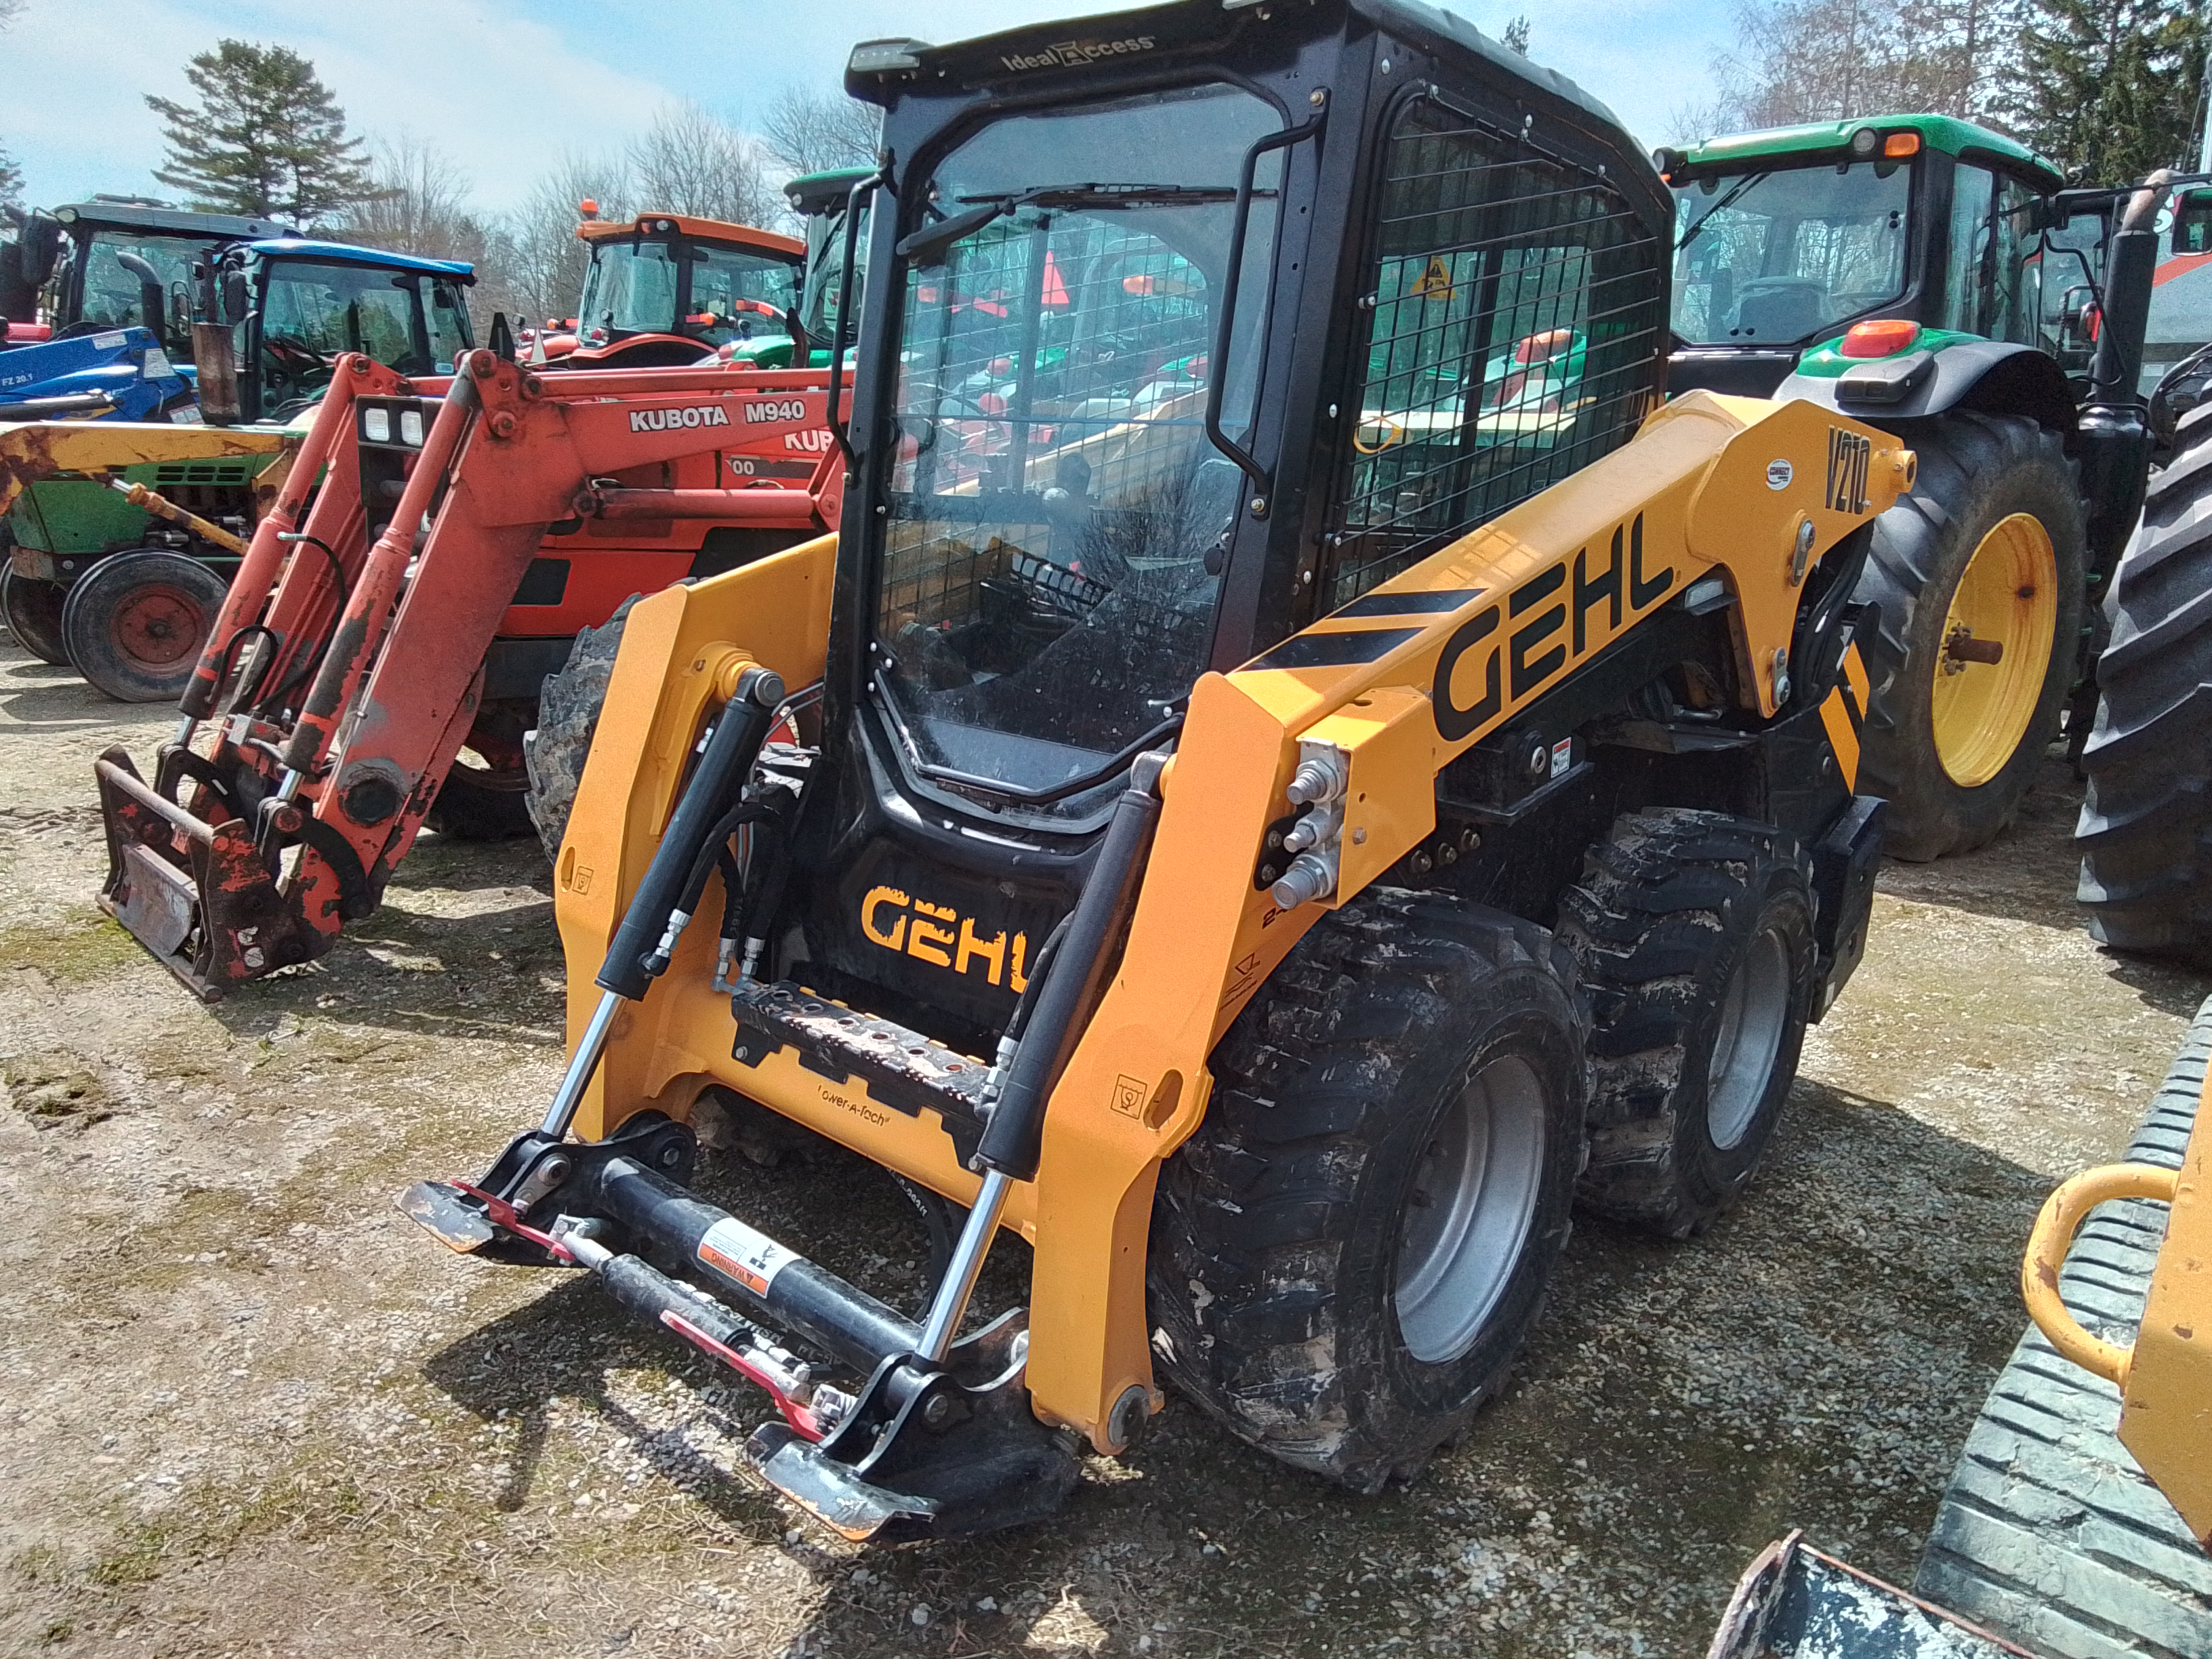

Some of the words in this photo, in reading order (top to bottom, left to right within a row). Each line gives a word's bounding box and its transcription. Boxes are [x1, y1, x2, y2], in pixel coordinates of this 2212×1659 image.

[1, 377, 15, 386] FZ
[16, 373, 33, 385] 20.1
[629, 406, 729, 432] KUBOTA
[745, 401, 805, 423] M940
[1824, 424, 1871, 516] V210
[1432, 510, 1674, 742] GEHL
[861, 885, 1029, 994] GEHL
[712, 1252, 745, 1281] WARNING
